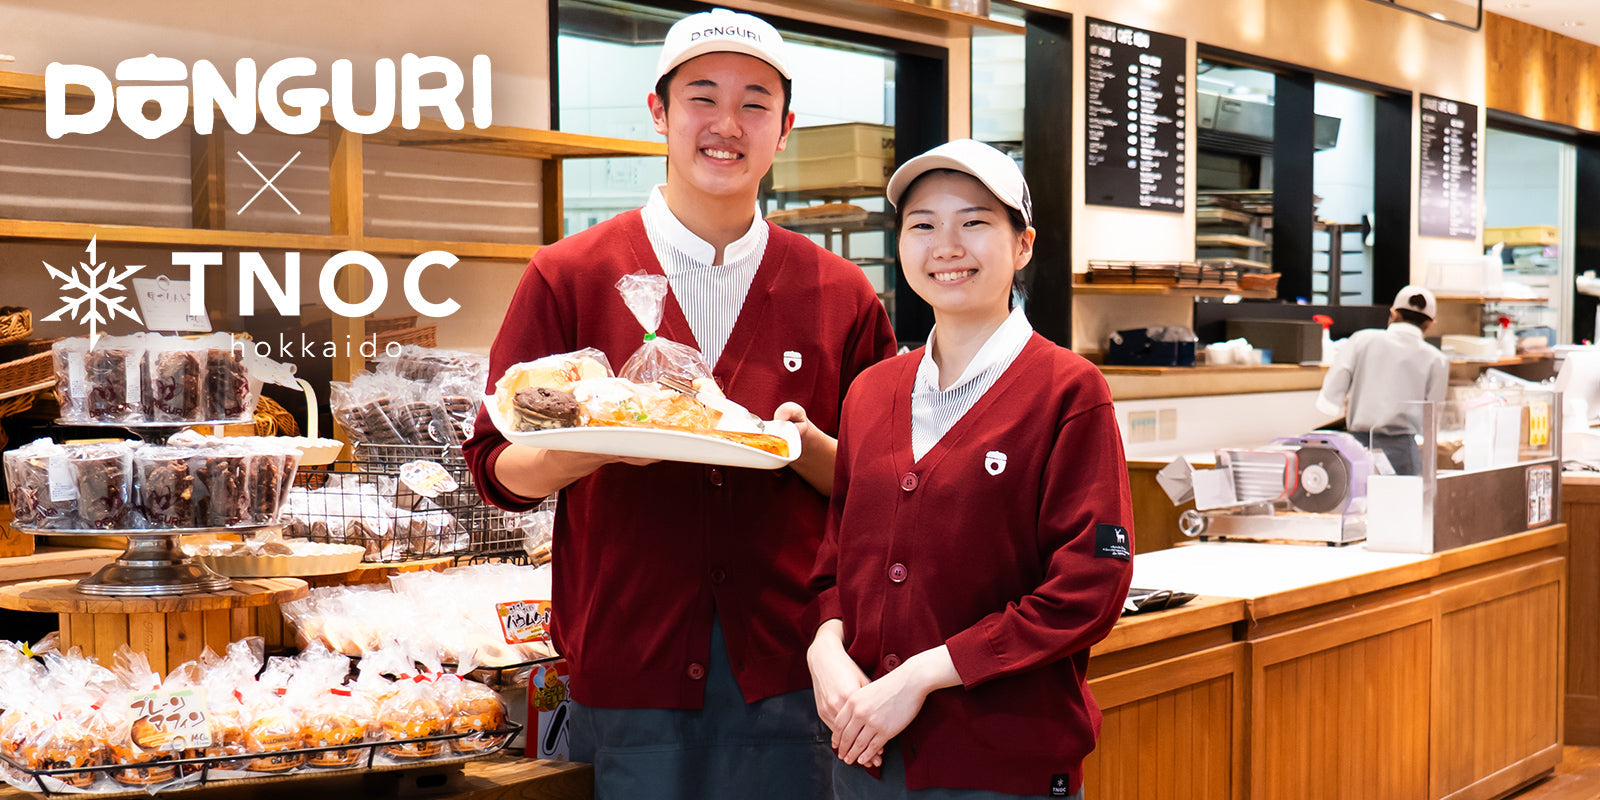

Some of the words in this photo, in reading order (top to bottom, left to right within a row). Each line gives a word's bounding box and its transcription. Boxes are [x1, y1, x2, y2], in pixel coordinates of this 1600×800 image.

[690, 25, 762, 43] DONGURI
[130, 696, 186, 717] プレーン
[148, 711, 206, 732] マフィン
